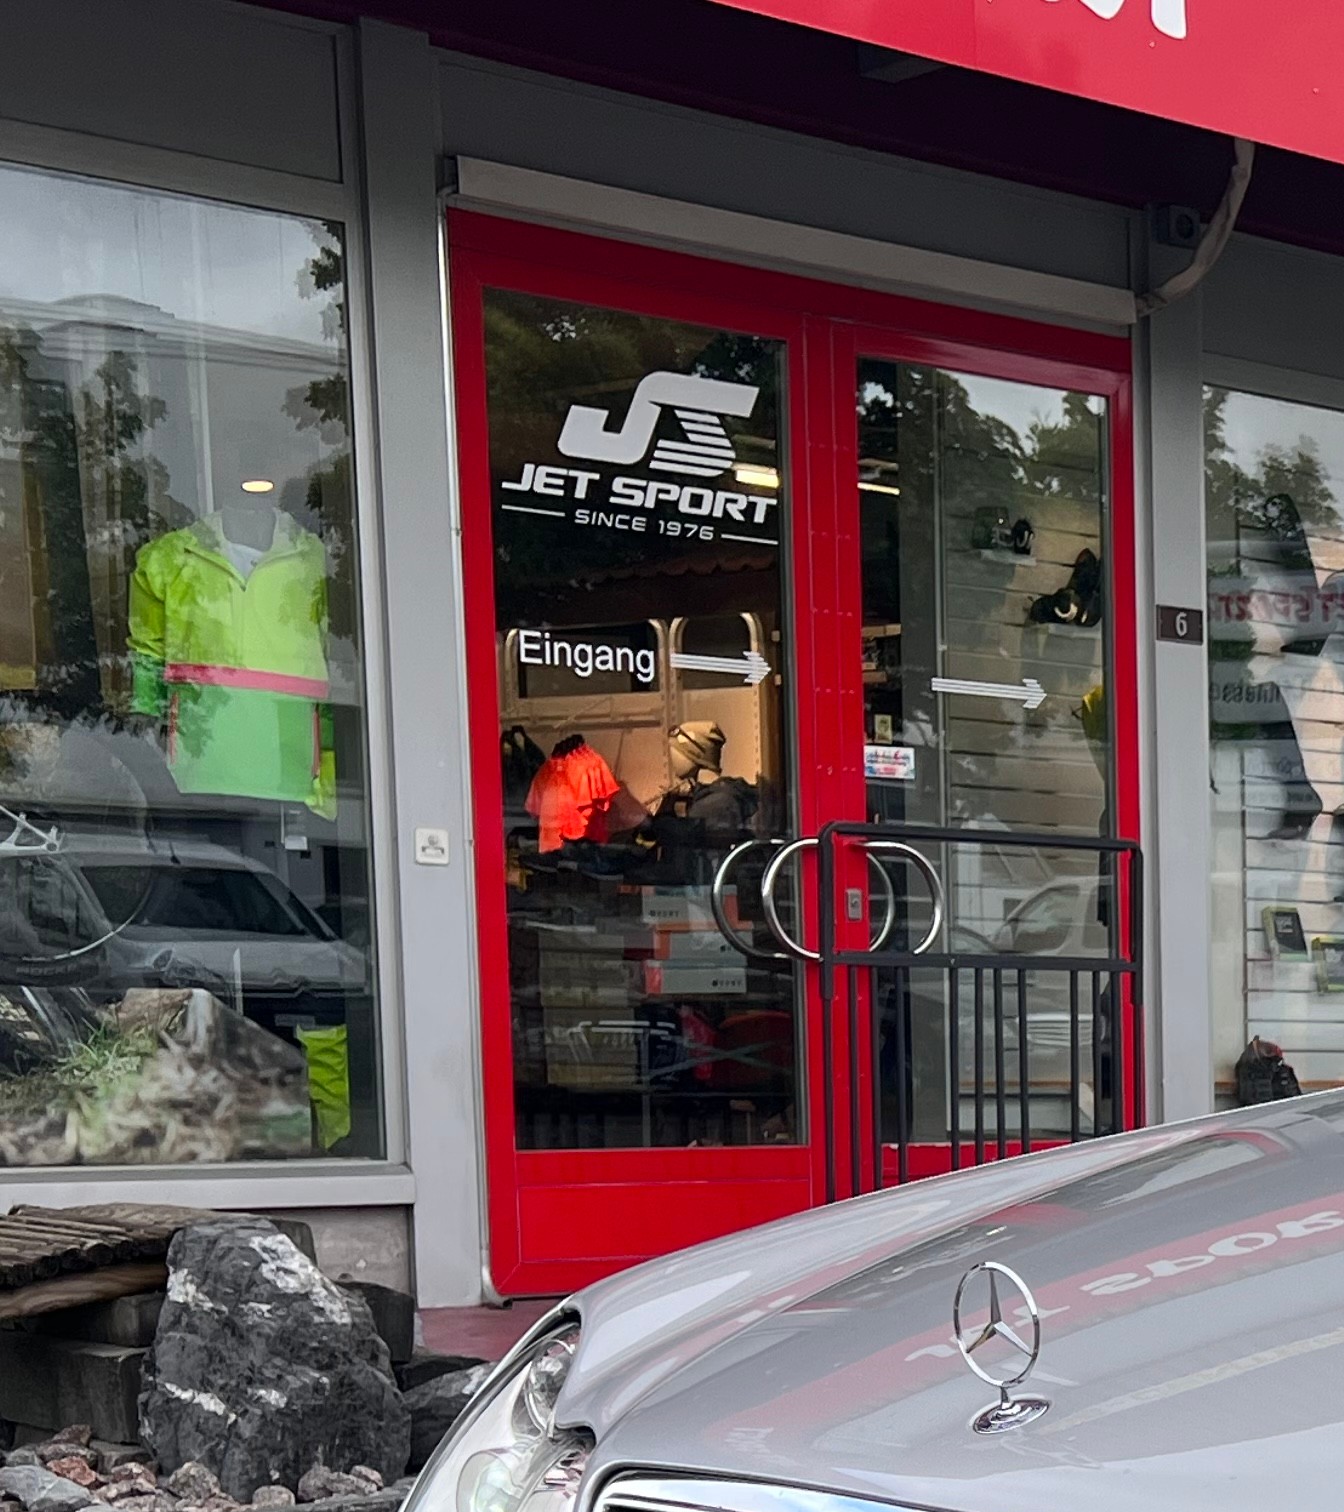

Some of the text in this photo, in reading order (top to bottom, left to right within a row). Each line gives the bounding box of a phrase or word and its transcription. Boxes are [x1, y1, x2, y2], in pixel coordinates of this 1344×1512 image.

[501, 463, 778, 525] JET SPORT
[574, 509, 715, 542] SINCE 1976
[1175, 611, 1187, 638] 6
[518, 629, 656, 684] Eingang
